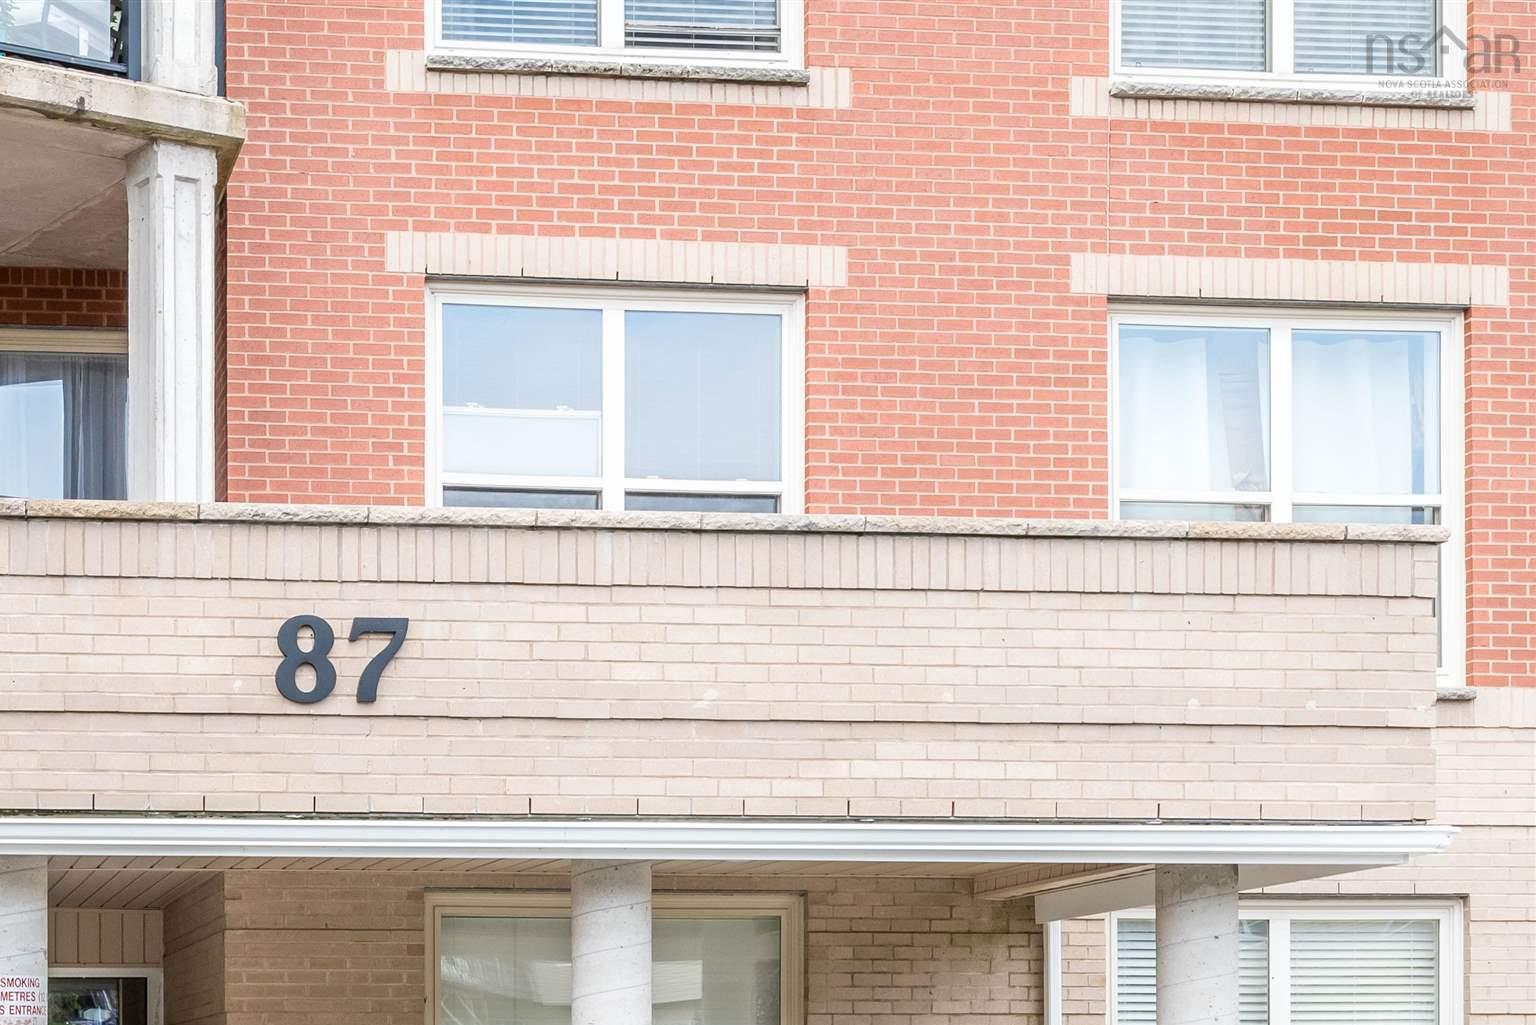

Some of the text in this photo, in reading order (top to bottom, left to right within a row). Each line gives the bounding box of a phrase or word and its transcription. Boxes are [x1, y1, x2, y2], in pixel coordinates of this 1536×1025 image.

[275, 614, 409, 705] 87
[0, 977, 40, 988] SMOKING
[0, 991, 36, 1002] METRES
